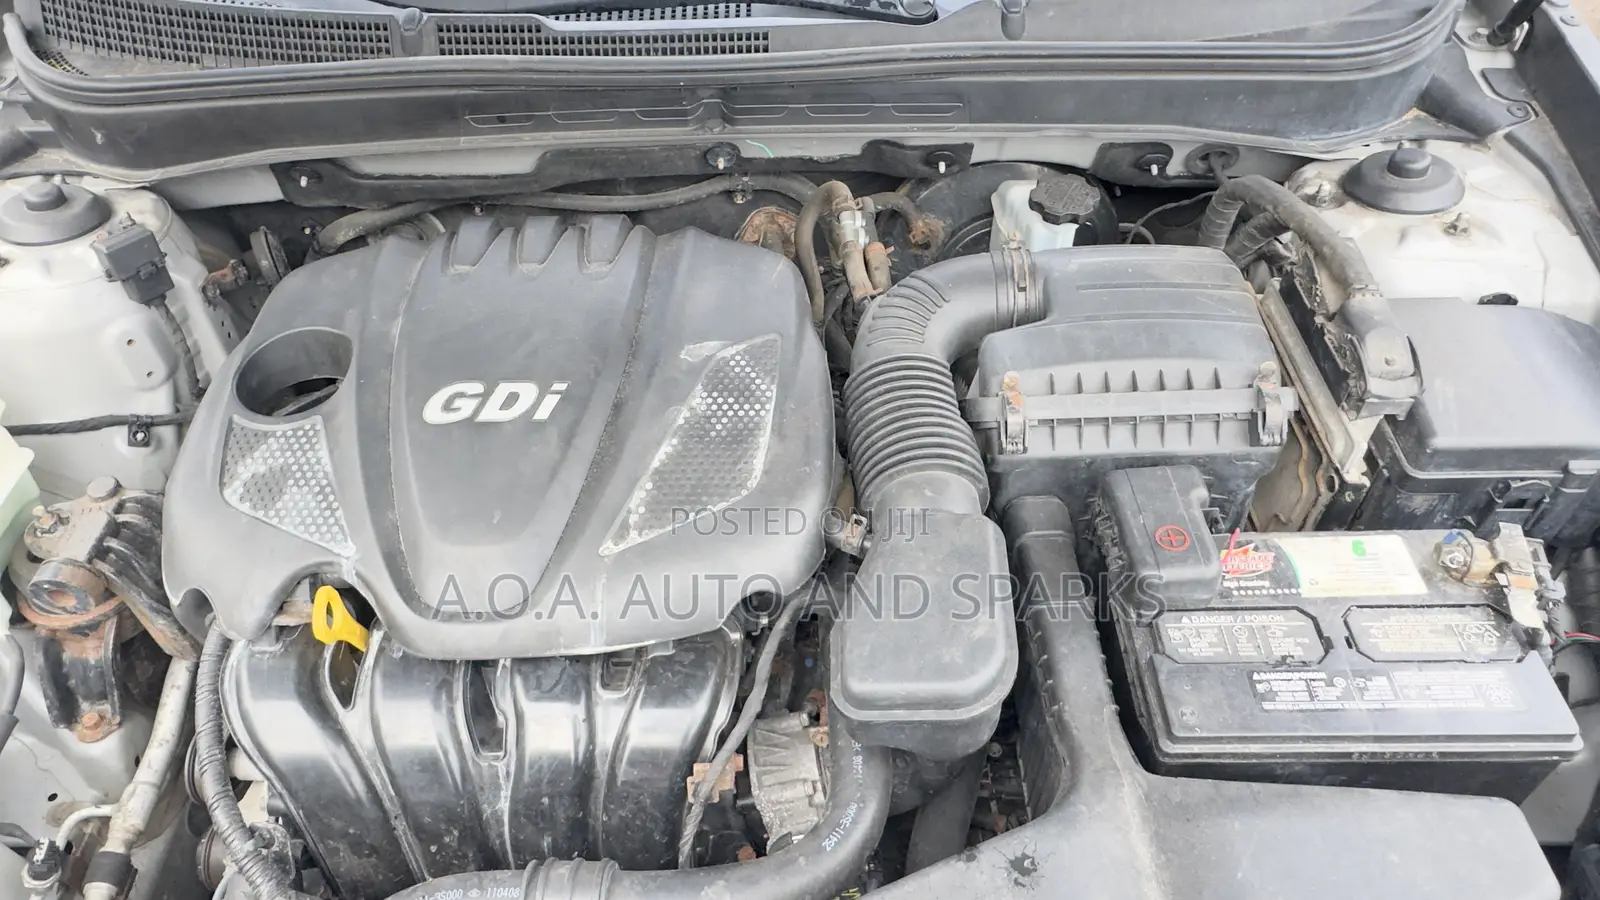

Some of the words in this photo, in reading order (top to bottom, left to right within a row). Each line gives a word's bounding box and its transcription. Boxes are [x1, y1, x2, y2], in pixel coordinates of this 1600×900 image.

[422, 380, 571, 425] GDi
[1192, 615, 1234, 624] DANGER
[1244, 614, 1285, 622] POISON
[487, 887, 520, 899] 110408
